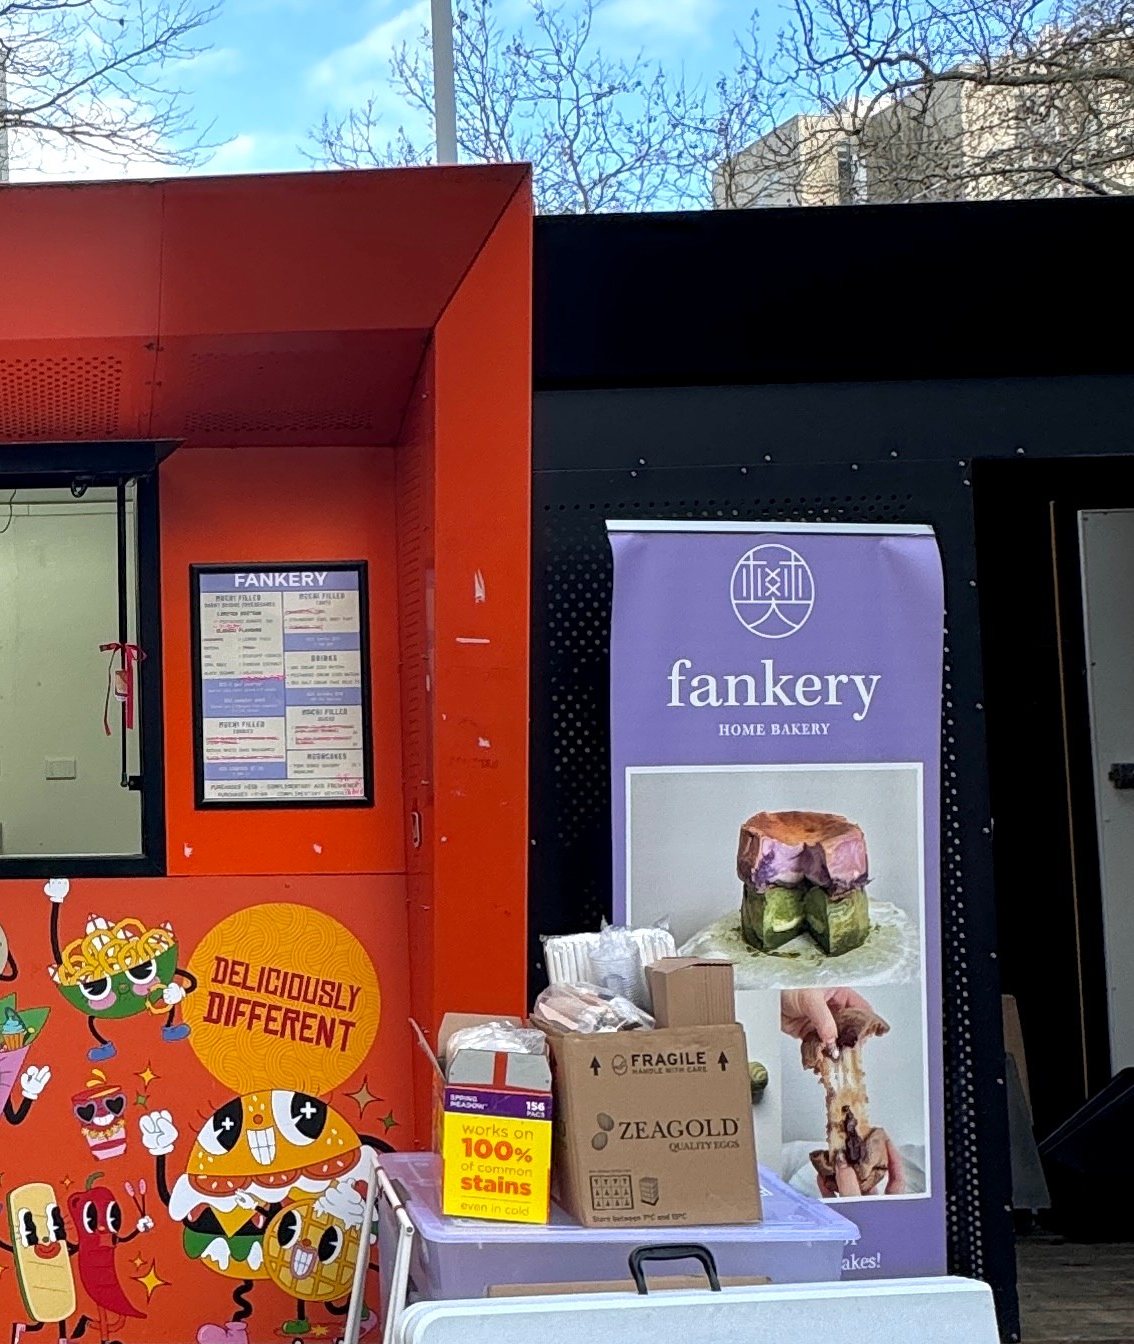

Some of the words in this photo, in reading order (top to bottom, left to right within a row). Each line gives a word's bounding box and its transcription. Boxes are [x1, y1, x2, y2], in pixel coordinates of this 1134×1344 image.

[234, 572, 328, 588] FANKERY
[666, 659, 881, 721] fankery
[719, 723, 765, 736] HOME
[771, 723, 830, 736] BAKERY
[211, 956, 362, 1013] DELICIOUSLY
[203, 990, 357, 1052] DIFFERENT
[631, 1051, 706, 1067] FRAGILE
[687, 1065, 707, 1073] CARE
[526, 1101, 545, 1111] 156
[462, 1124, 508, 1138] works
[514, 1128, 533, 1140] on
[618, 1117, 738, 1140] ZEAGOLD
[461, 1137, 532, 1164] 100%
[669, 1141, 711, 1152] QUALITY
[714, 1140, 740, 1150] EGGS
[461, 1161, 474, 1172] of
[477, 1164, 532, 1177] common
[460, 1176, 532, 1196] stains
[460, 1202, 487, 1213] even
[491, 1203, 501, 1214] in
[505, 1204, 529, 1217] cold
[841, 1252, 881, 1270] akes!
